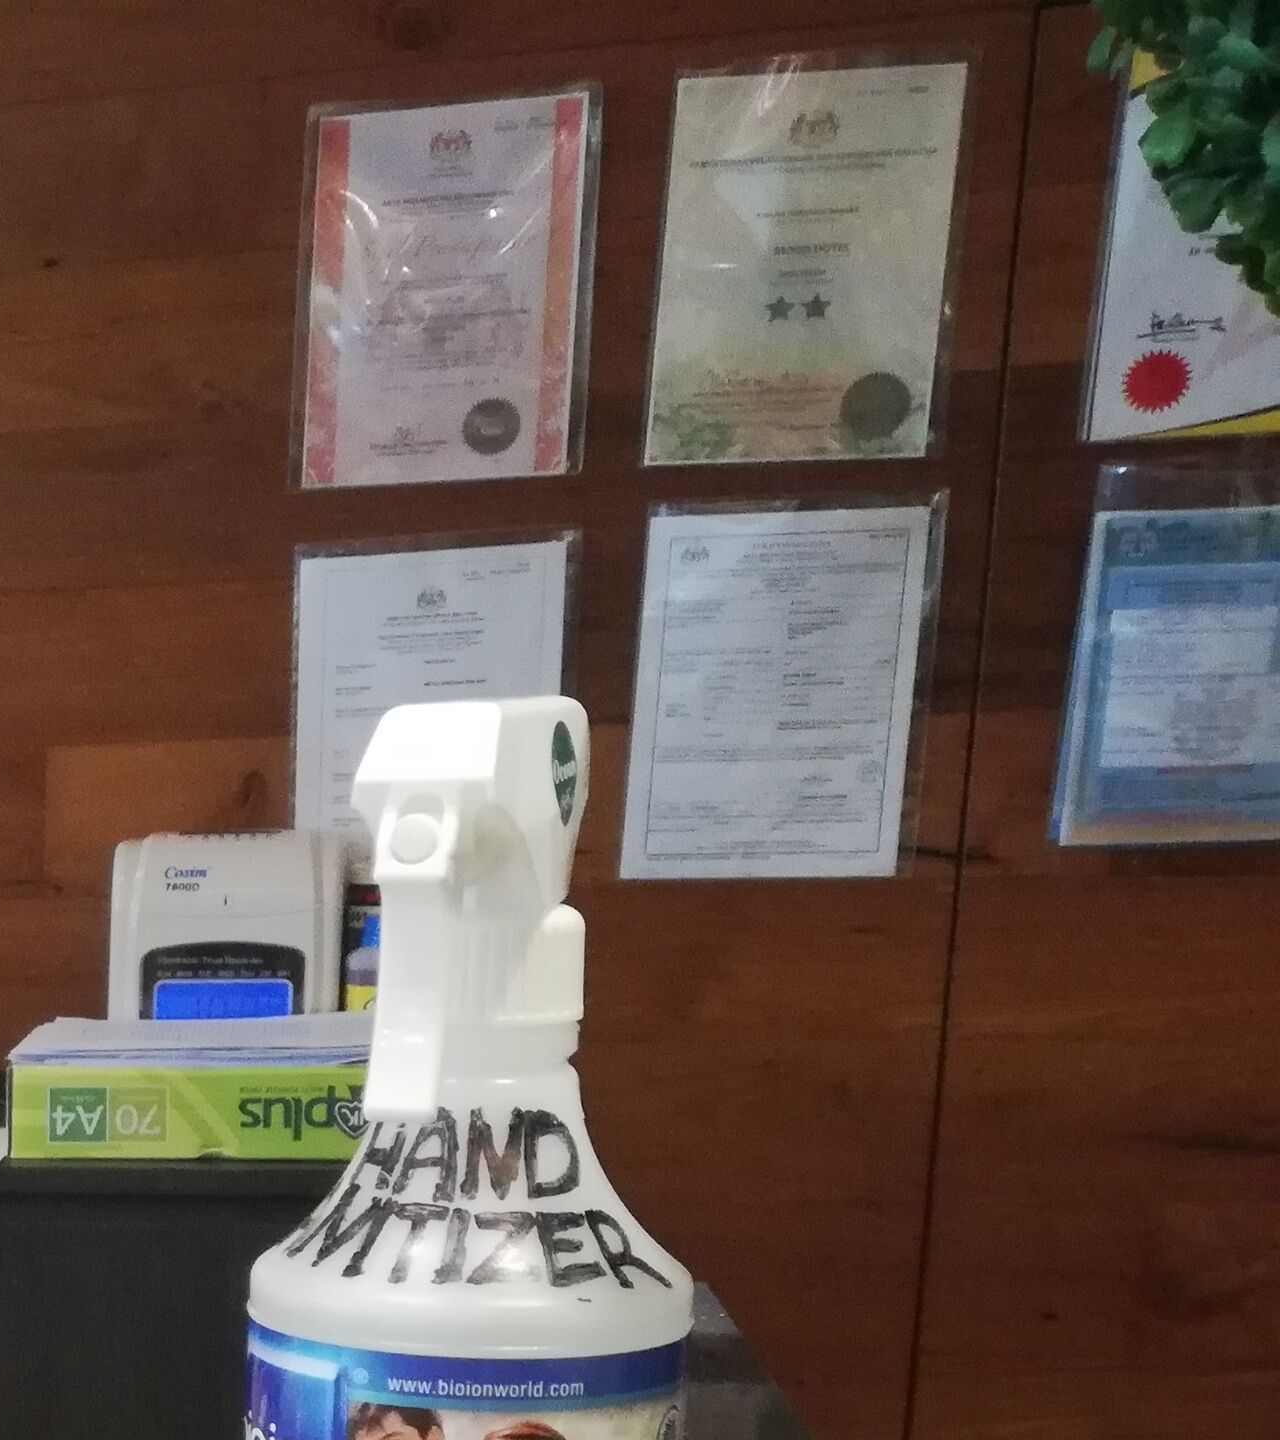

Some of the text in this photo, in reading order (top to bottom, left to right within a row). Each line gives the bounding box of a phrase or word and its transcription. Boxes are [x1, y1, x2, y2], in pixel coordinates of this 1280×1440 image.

[52, 1103, 161, 1135] 70 A4
[238, 1085, 336, 1143] plus
[349, 1106, 581, 1203] HAND
[386, 1376, 584, 1398] www.bioionworld.com
